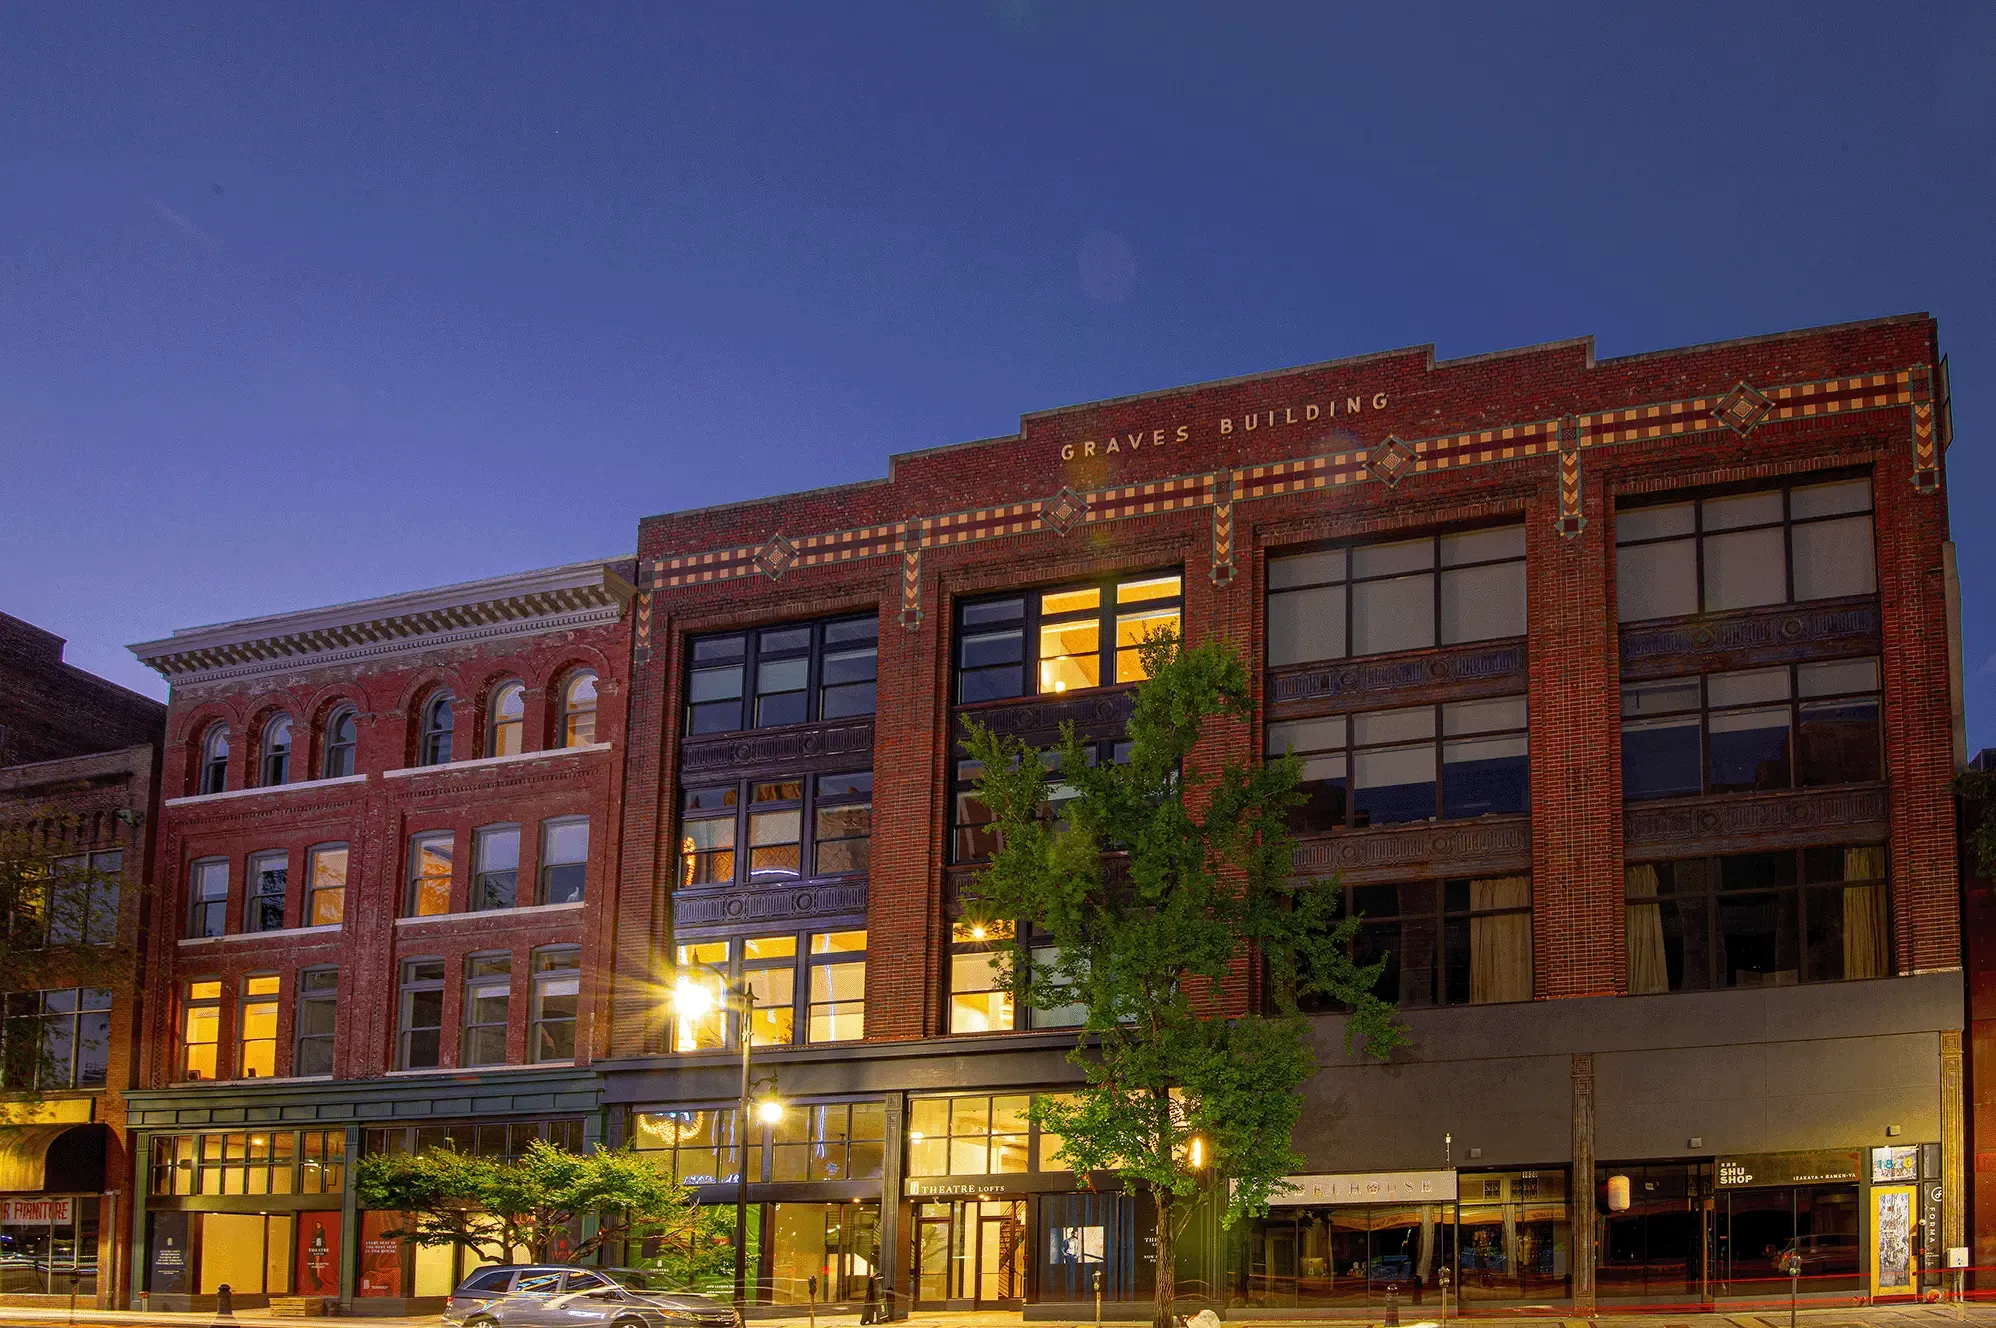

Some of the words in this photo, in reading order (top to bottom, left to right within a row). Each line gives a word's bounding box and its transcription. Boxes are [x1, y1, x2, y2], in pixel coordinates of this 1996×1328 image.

[1061, 425, 1189, 461] GRAVES
[1220, 391, 1388, 435] BUILDING
[1720, 1167, 1745, 1176] SHU
[1720, 1175, 1753, 1185] SHOP
[922, 1184, 975, 1194] THEATRE
